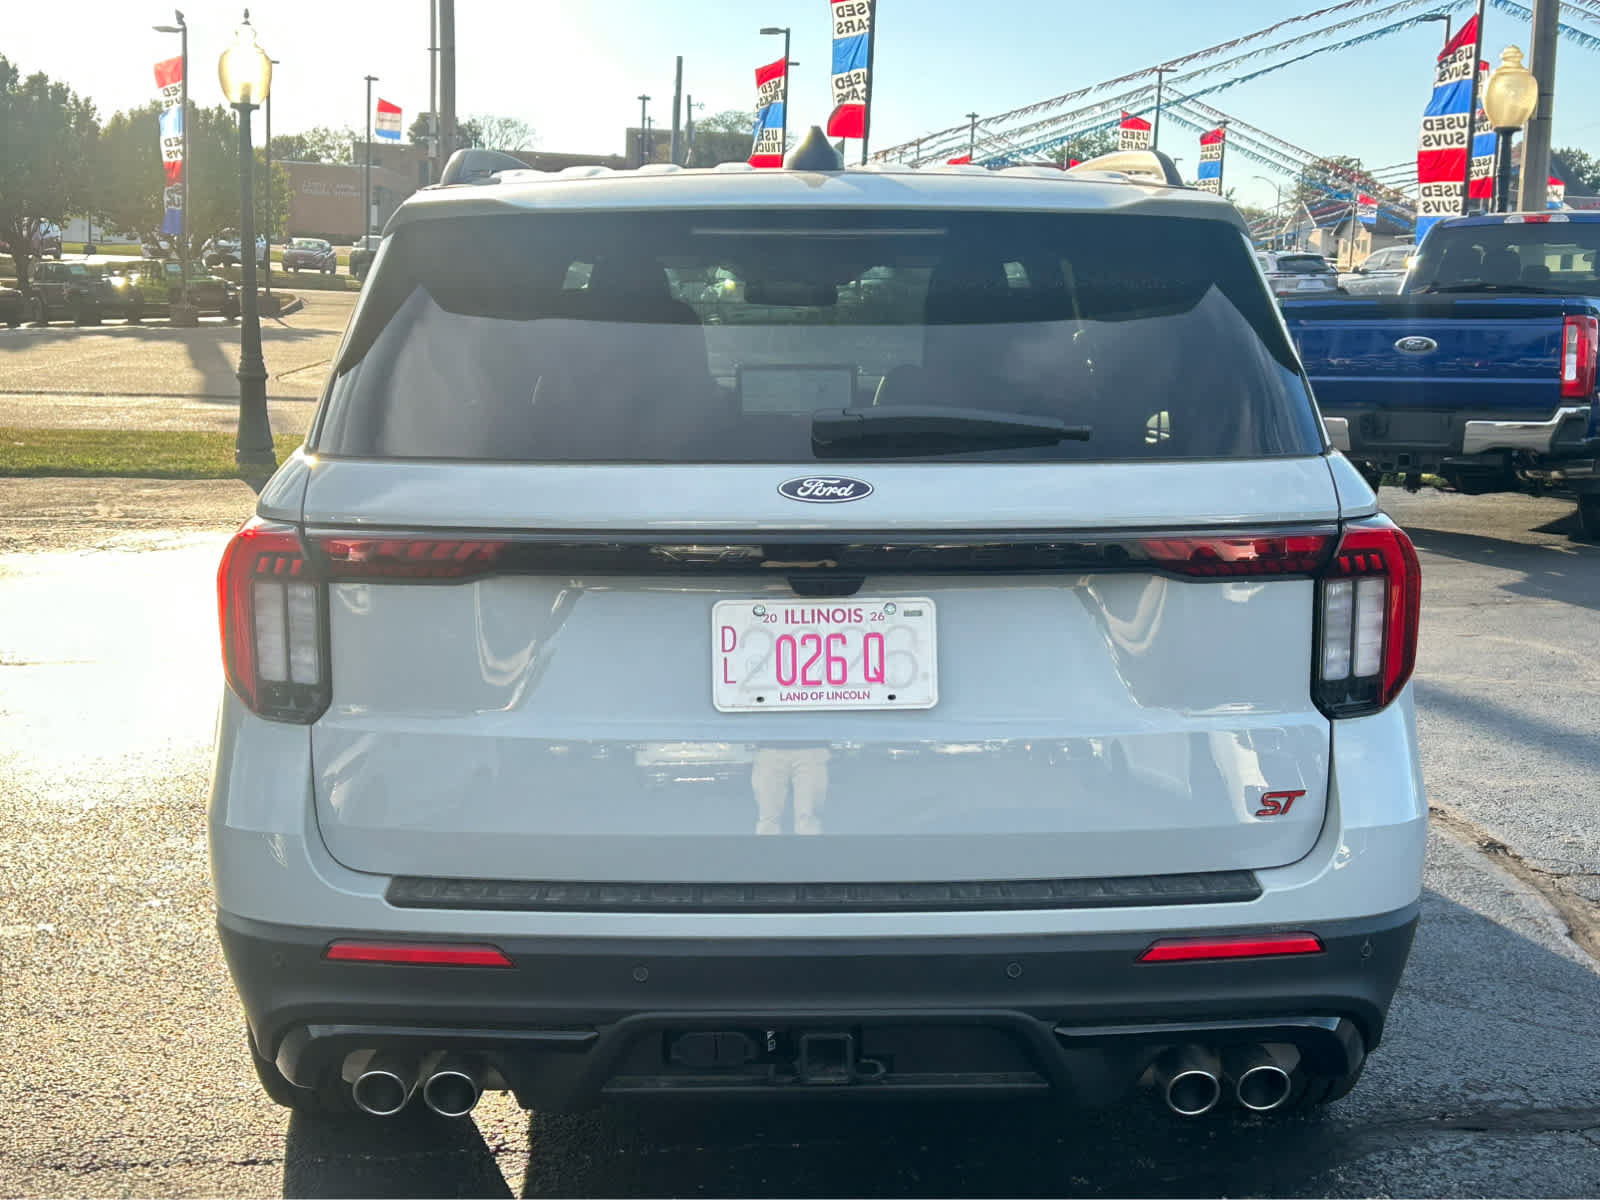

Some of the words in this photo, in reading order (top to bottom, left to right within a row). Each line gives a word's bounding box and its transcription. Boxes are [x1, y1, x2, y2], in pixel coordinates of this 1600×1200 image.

[797, 480, 854, 496] Ford
[763, 613, 778, 624] 20
[784, 608, 863, 625] ILLINOIS
[870, 612, 886, 622] 26
[779, 692, 809, 701] LAND
[810, 691, 825, 701] OF
[826, 690, 871, 700] LINCOLN
[1255, 790, 1306, 817] ST
